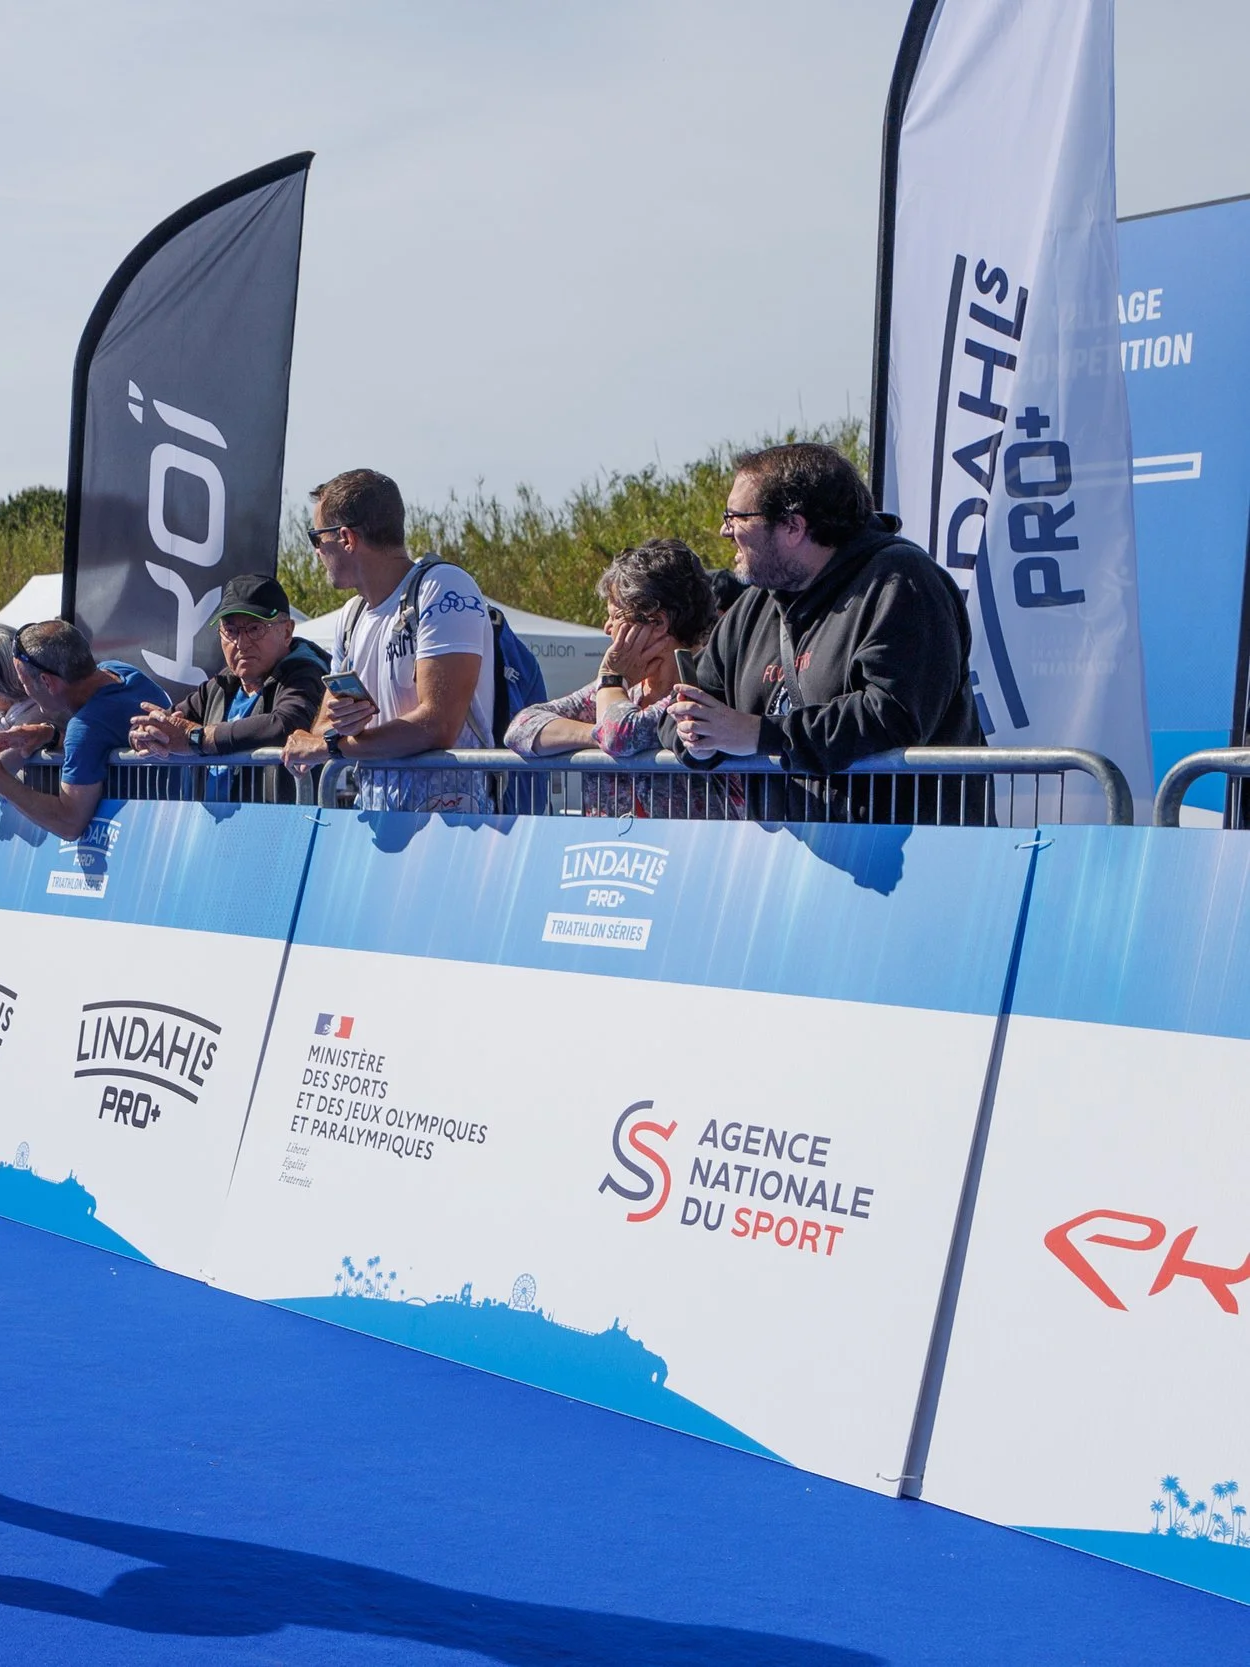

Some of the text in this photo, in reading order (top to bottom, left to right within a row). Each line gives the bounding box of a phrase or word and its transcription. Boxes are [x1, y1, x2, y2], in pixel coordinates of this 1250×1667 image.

[52, 876, 84, 891] TRIATHLON
[586, 888, 627, 908] PRO+
[550, 919, 644, 942] TRIATHLON SÉRIES
[307, 1045, 386, 1073] MINISTÈRE
[302, 1068, 389, 1099] DES SPORTS
[98, 1085, 161, 1129] PRO+
[296, 1091, 488, 1144] ET DES JEUX OLYMPIQUES
[285, 1141, 310, 1157] Liberté
[290, 1115, 434, 1160] ET PARALYMPIQUES
[697, 1118, 832, 1168] AGENCE
[278, 1171, 314, 1189] Fraternité
[689, 1156, 874, 1220] NATIONALE
[680, 1196, 845, 1257] DU SPORT
